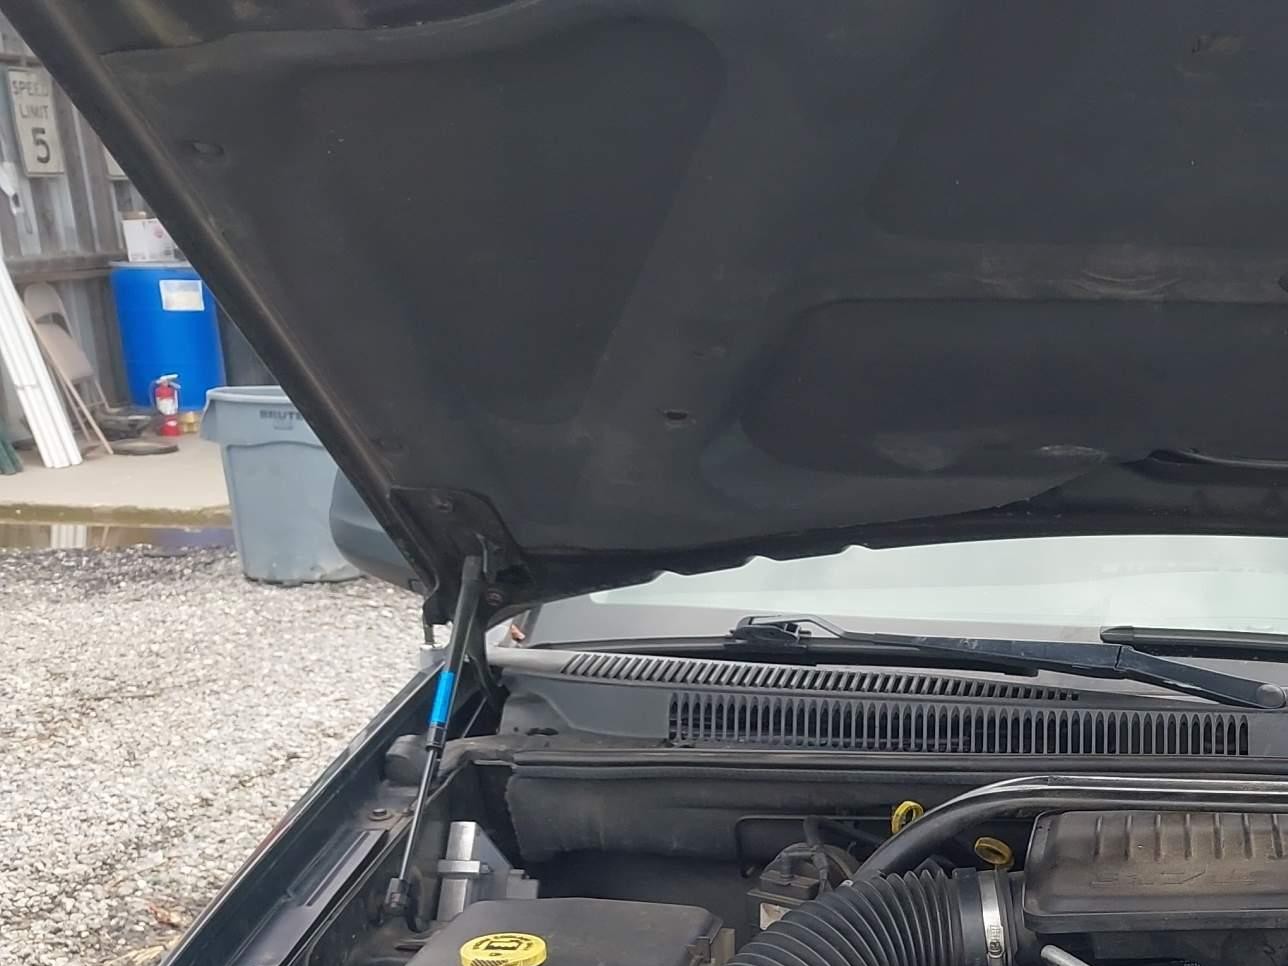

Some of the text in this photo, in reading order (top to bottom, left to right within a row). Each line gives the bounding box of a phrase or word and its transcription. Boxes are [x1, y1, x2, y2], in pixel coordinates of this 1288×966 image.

[12, 80, 49, 96] SPEED
[19, 103, 49, 119] LIMIT
[31, 127, 51, 164] 5
